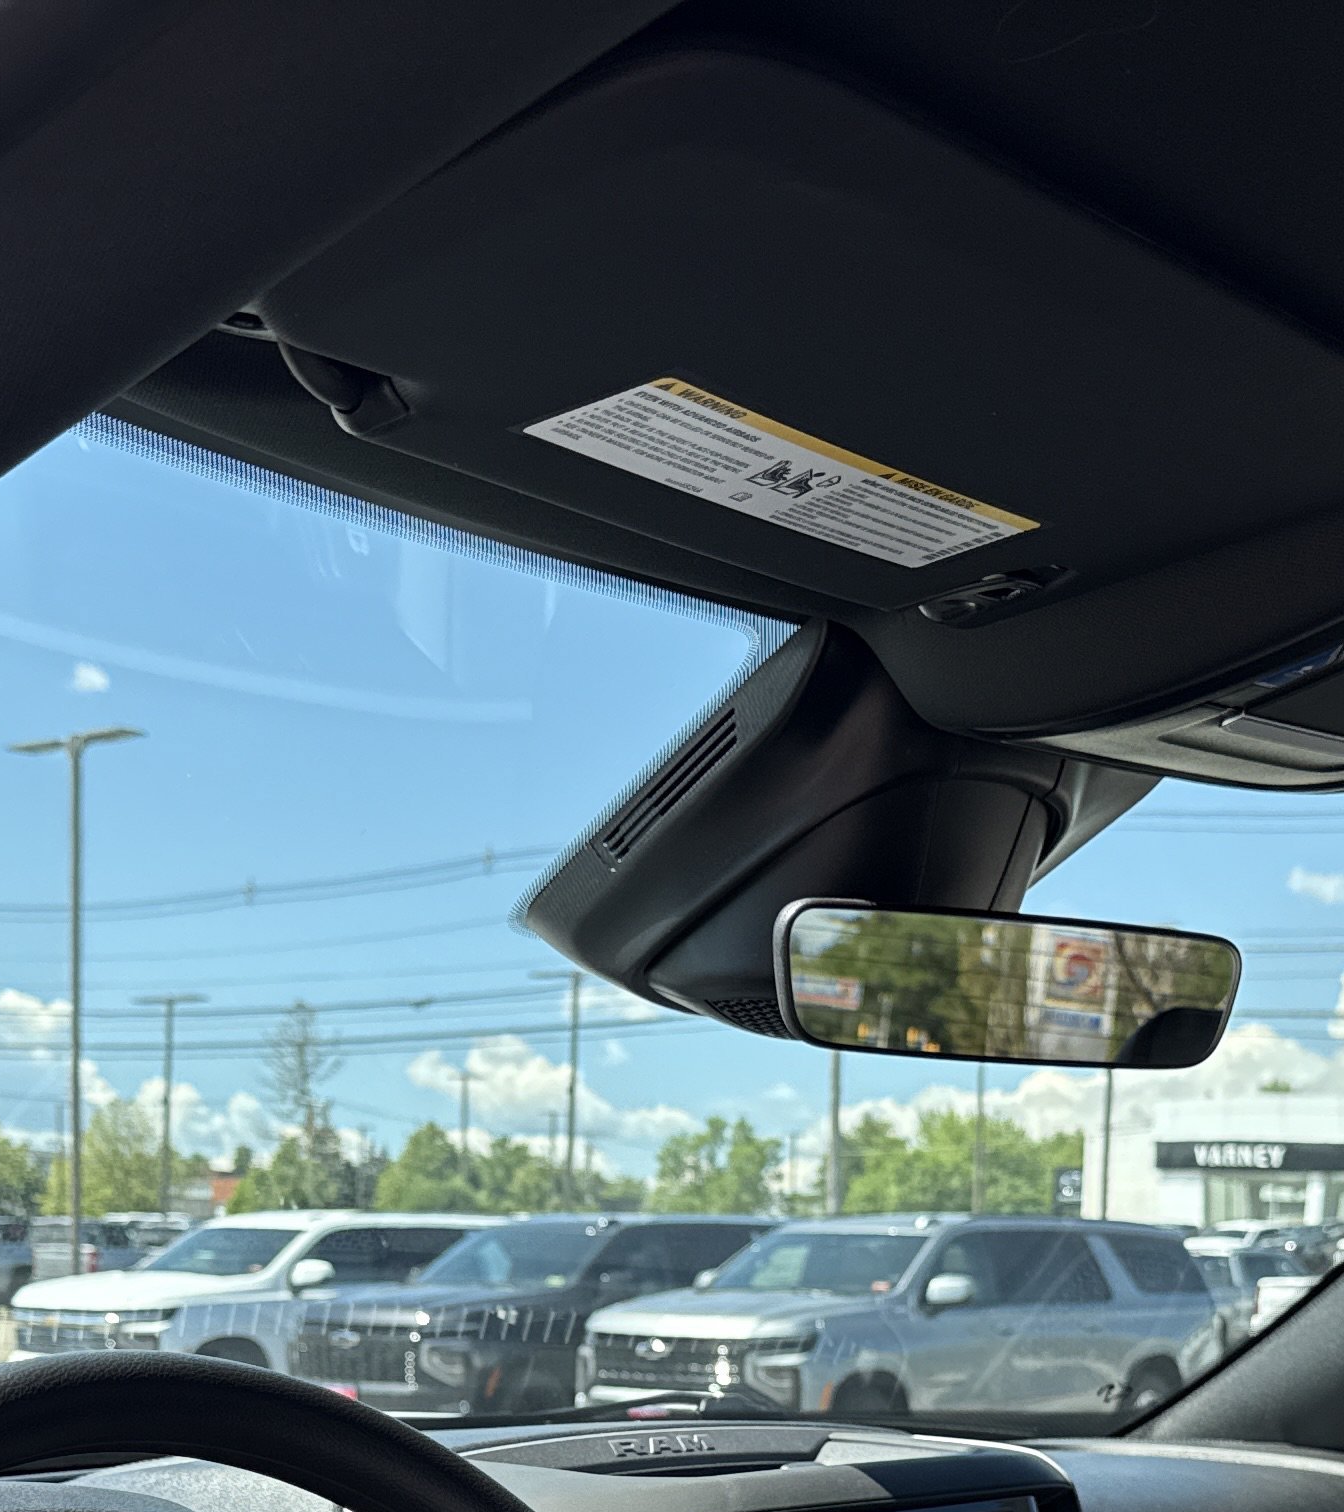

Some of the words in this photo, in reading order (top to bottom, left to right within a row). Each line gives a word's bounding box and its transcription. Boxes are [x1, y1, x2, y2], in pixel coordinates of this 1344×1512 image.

[677, 389, 747, 419] WARNING
[1194, 1143, 1287, 1168] VARNEY
[608, 1434, 715, 1457] RAM
